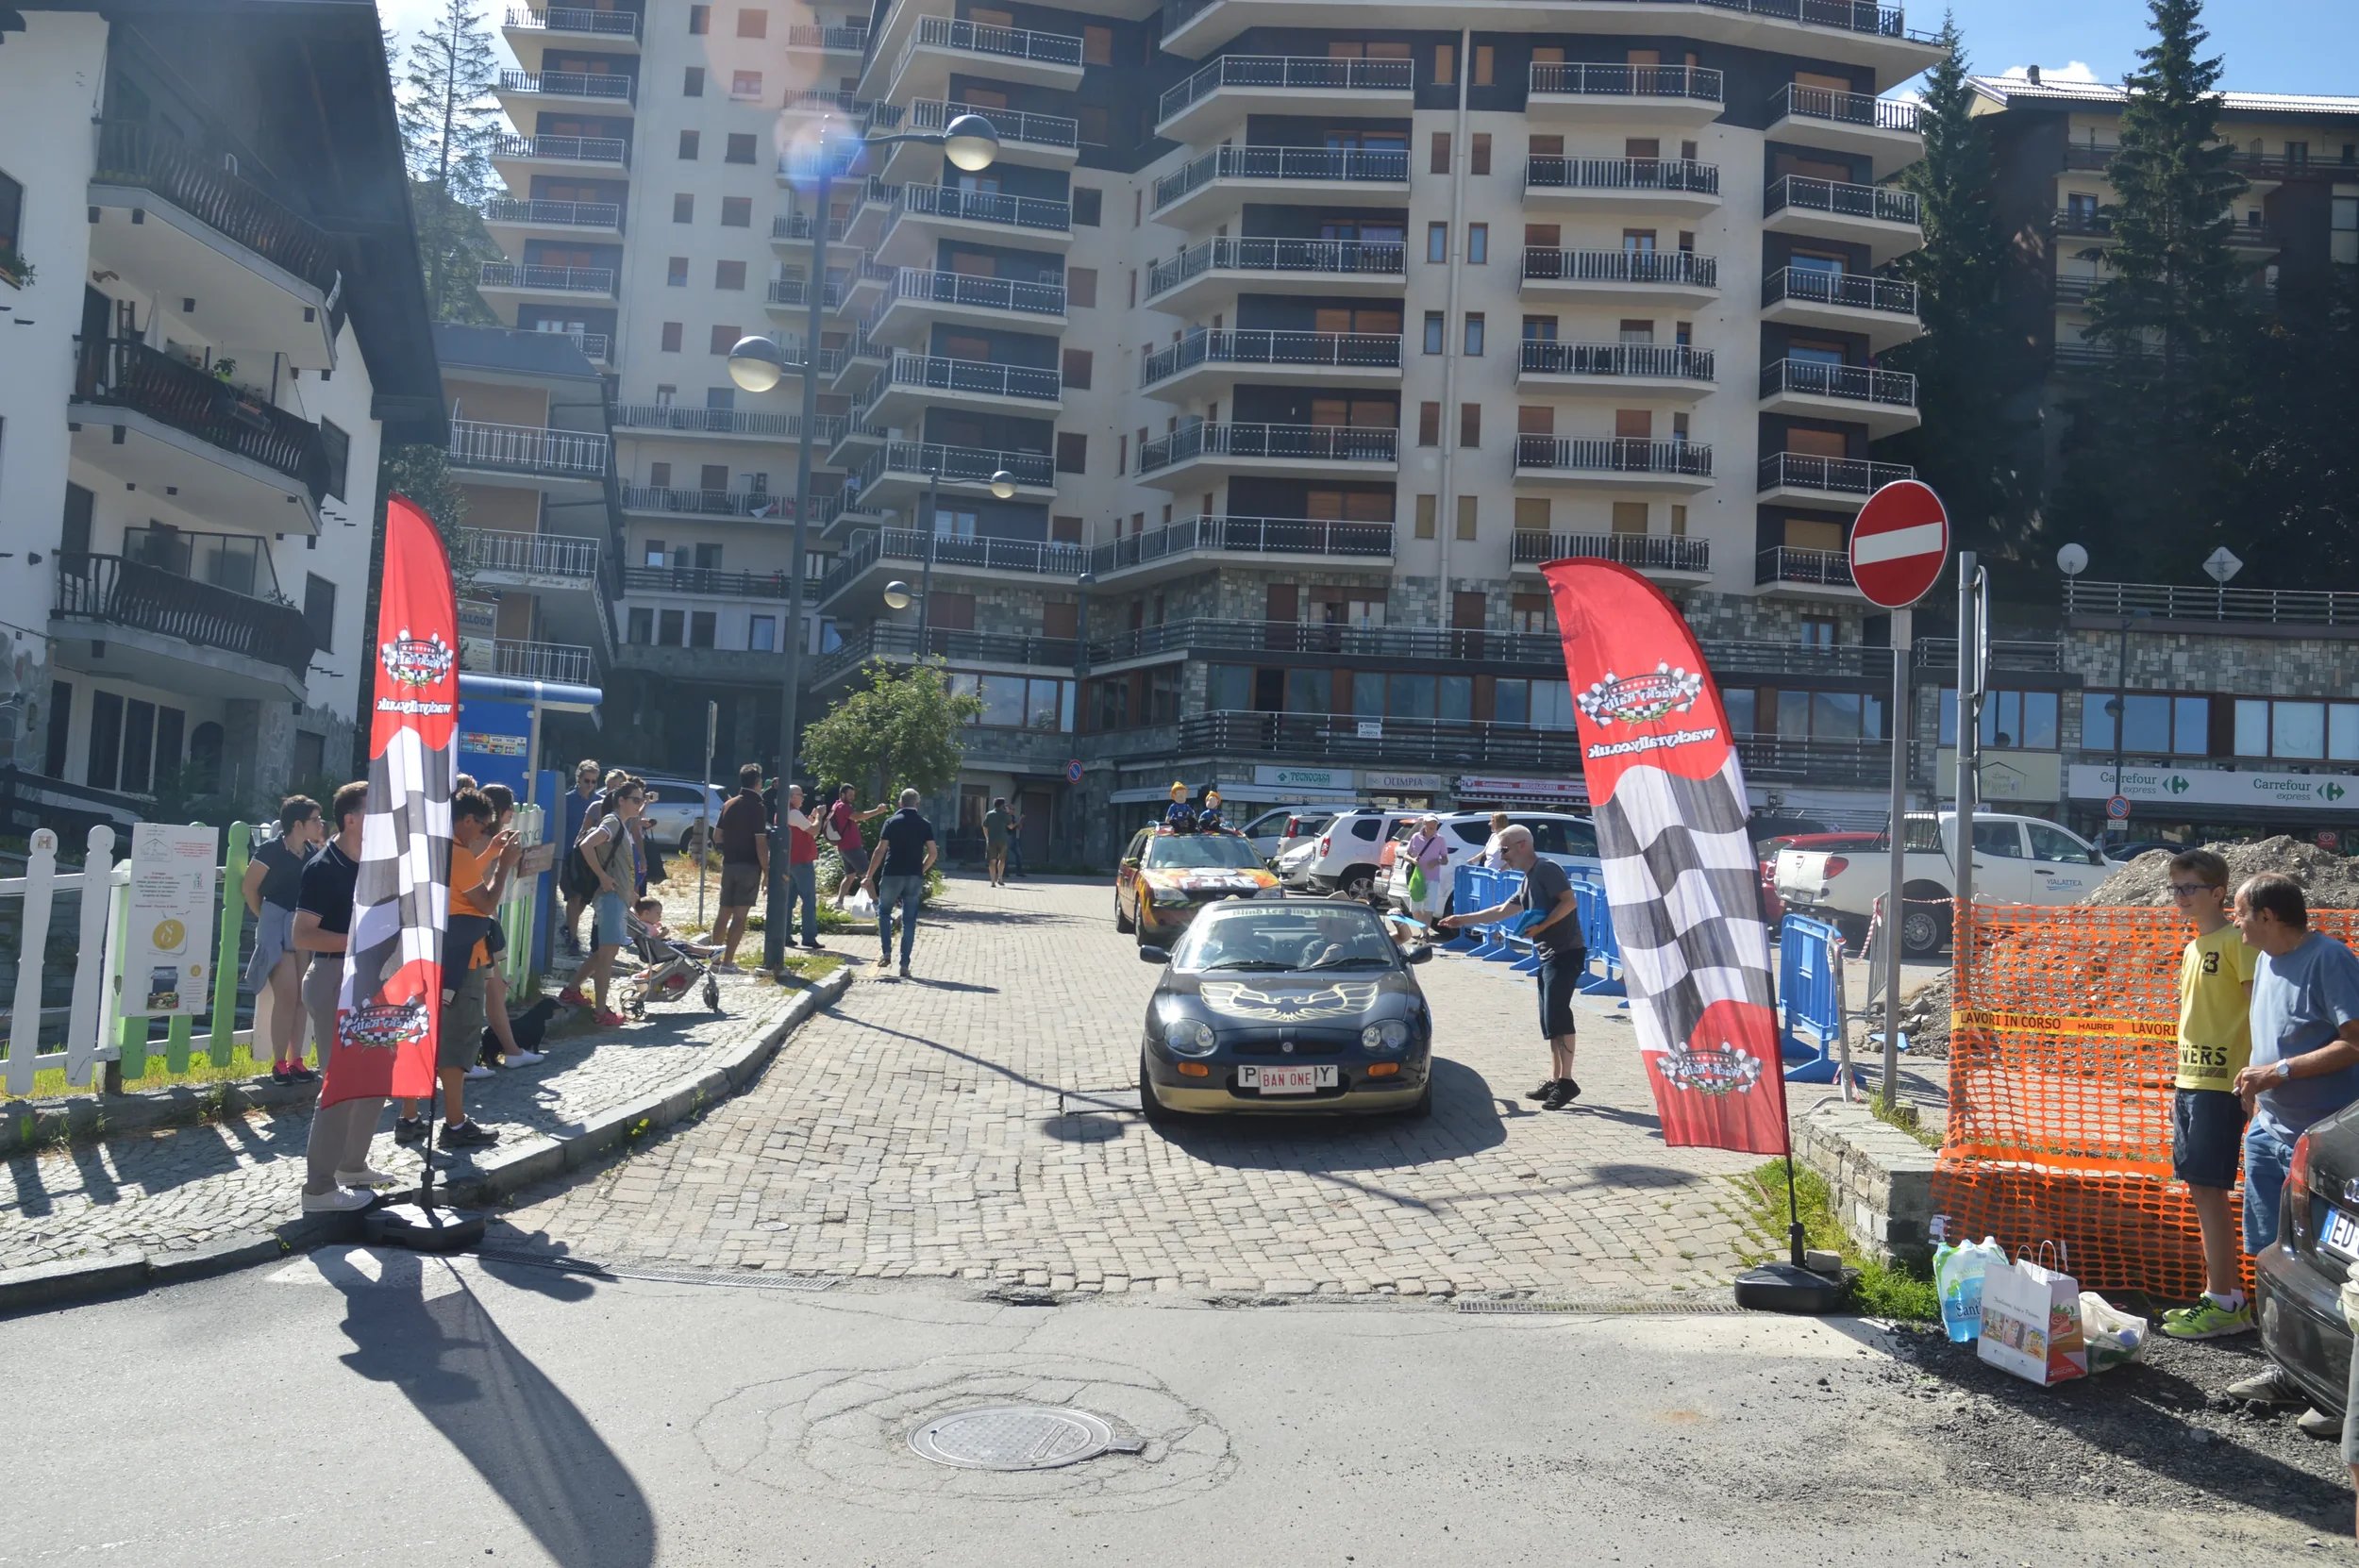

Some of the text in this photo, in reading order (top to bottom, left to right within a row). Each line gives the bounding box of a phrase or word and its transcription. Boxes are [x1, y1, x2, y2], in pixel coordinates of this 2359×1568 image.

[1290, 772, 1330, 784] TECNOCASA
[1383, 776, 1423, 787] OLIMPIA
[2100, 771, 2157, 784] Carefour
[2123, 785, 2157, 794] express
[2253, 778, 2311, 791] Carrefour
[2276, 792, 2310, 801] express
[1180, 876, 1260, 890] FIRE
[1961, 1012, 2061, 1029] LAVORI IN CORSO
[2132, 1023, 2177, 1036] LAVORI
[1263, 1073, 1312, 1087] BAN ONE
